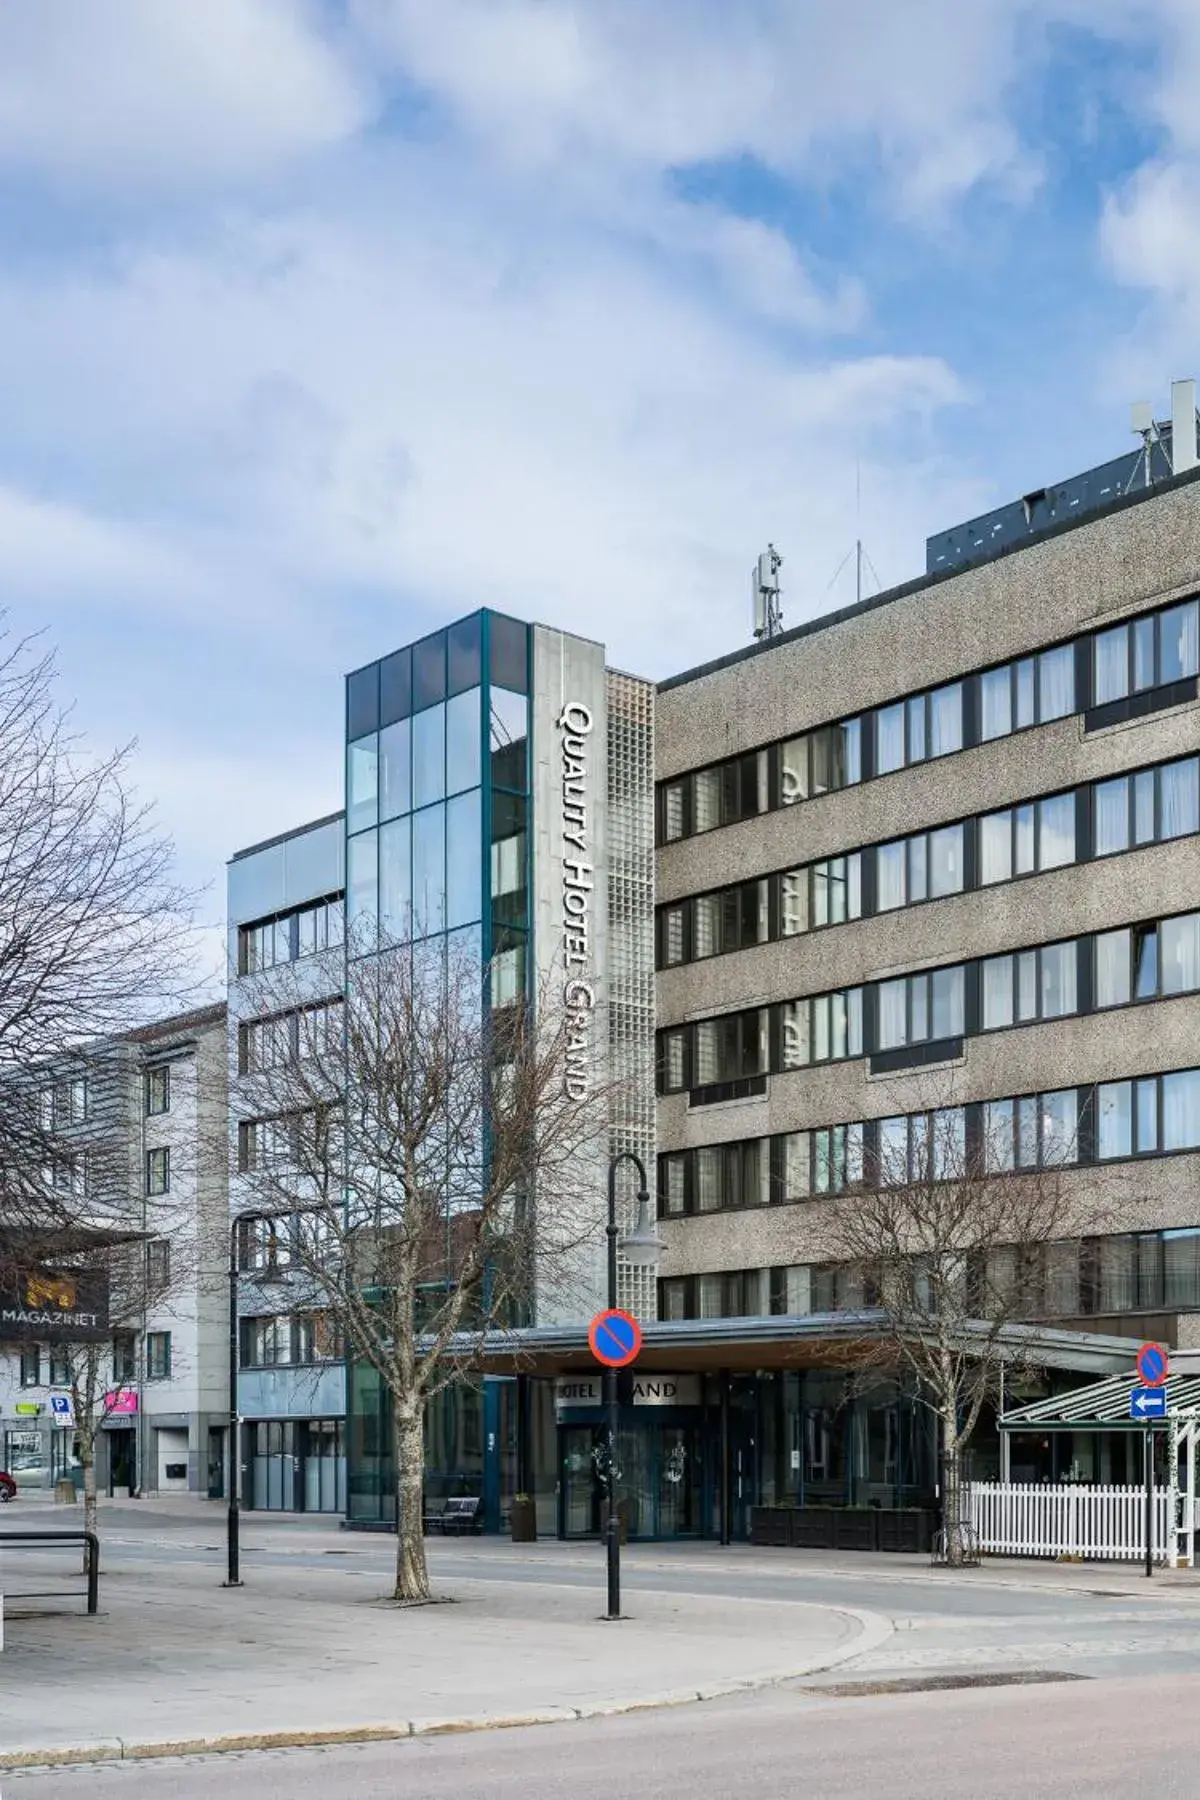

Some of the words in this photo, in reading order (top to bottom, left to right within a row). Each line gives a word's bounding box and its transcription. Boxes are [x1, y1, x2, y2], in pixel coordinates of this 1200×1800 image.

[557, 702, 593, 851] QUALITY
[563, 859, 594, 968] HOTEL
[564, 980, 596, 1101] GRAND
[2, 1309, 98, 1326] MAGAZINET
[632, 1382, 677, 1398] AND
